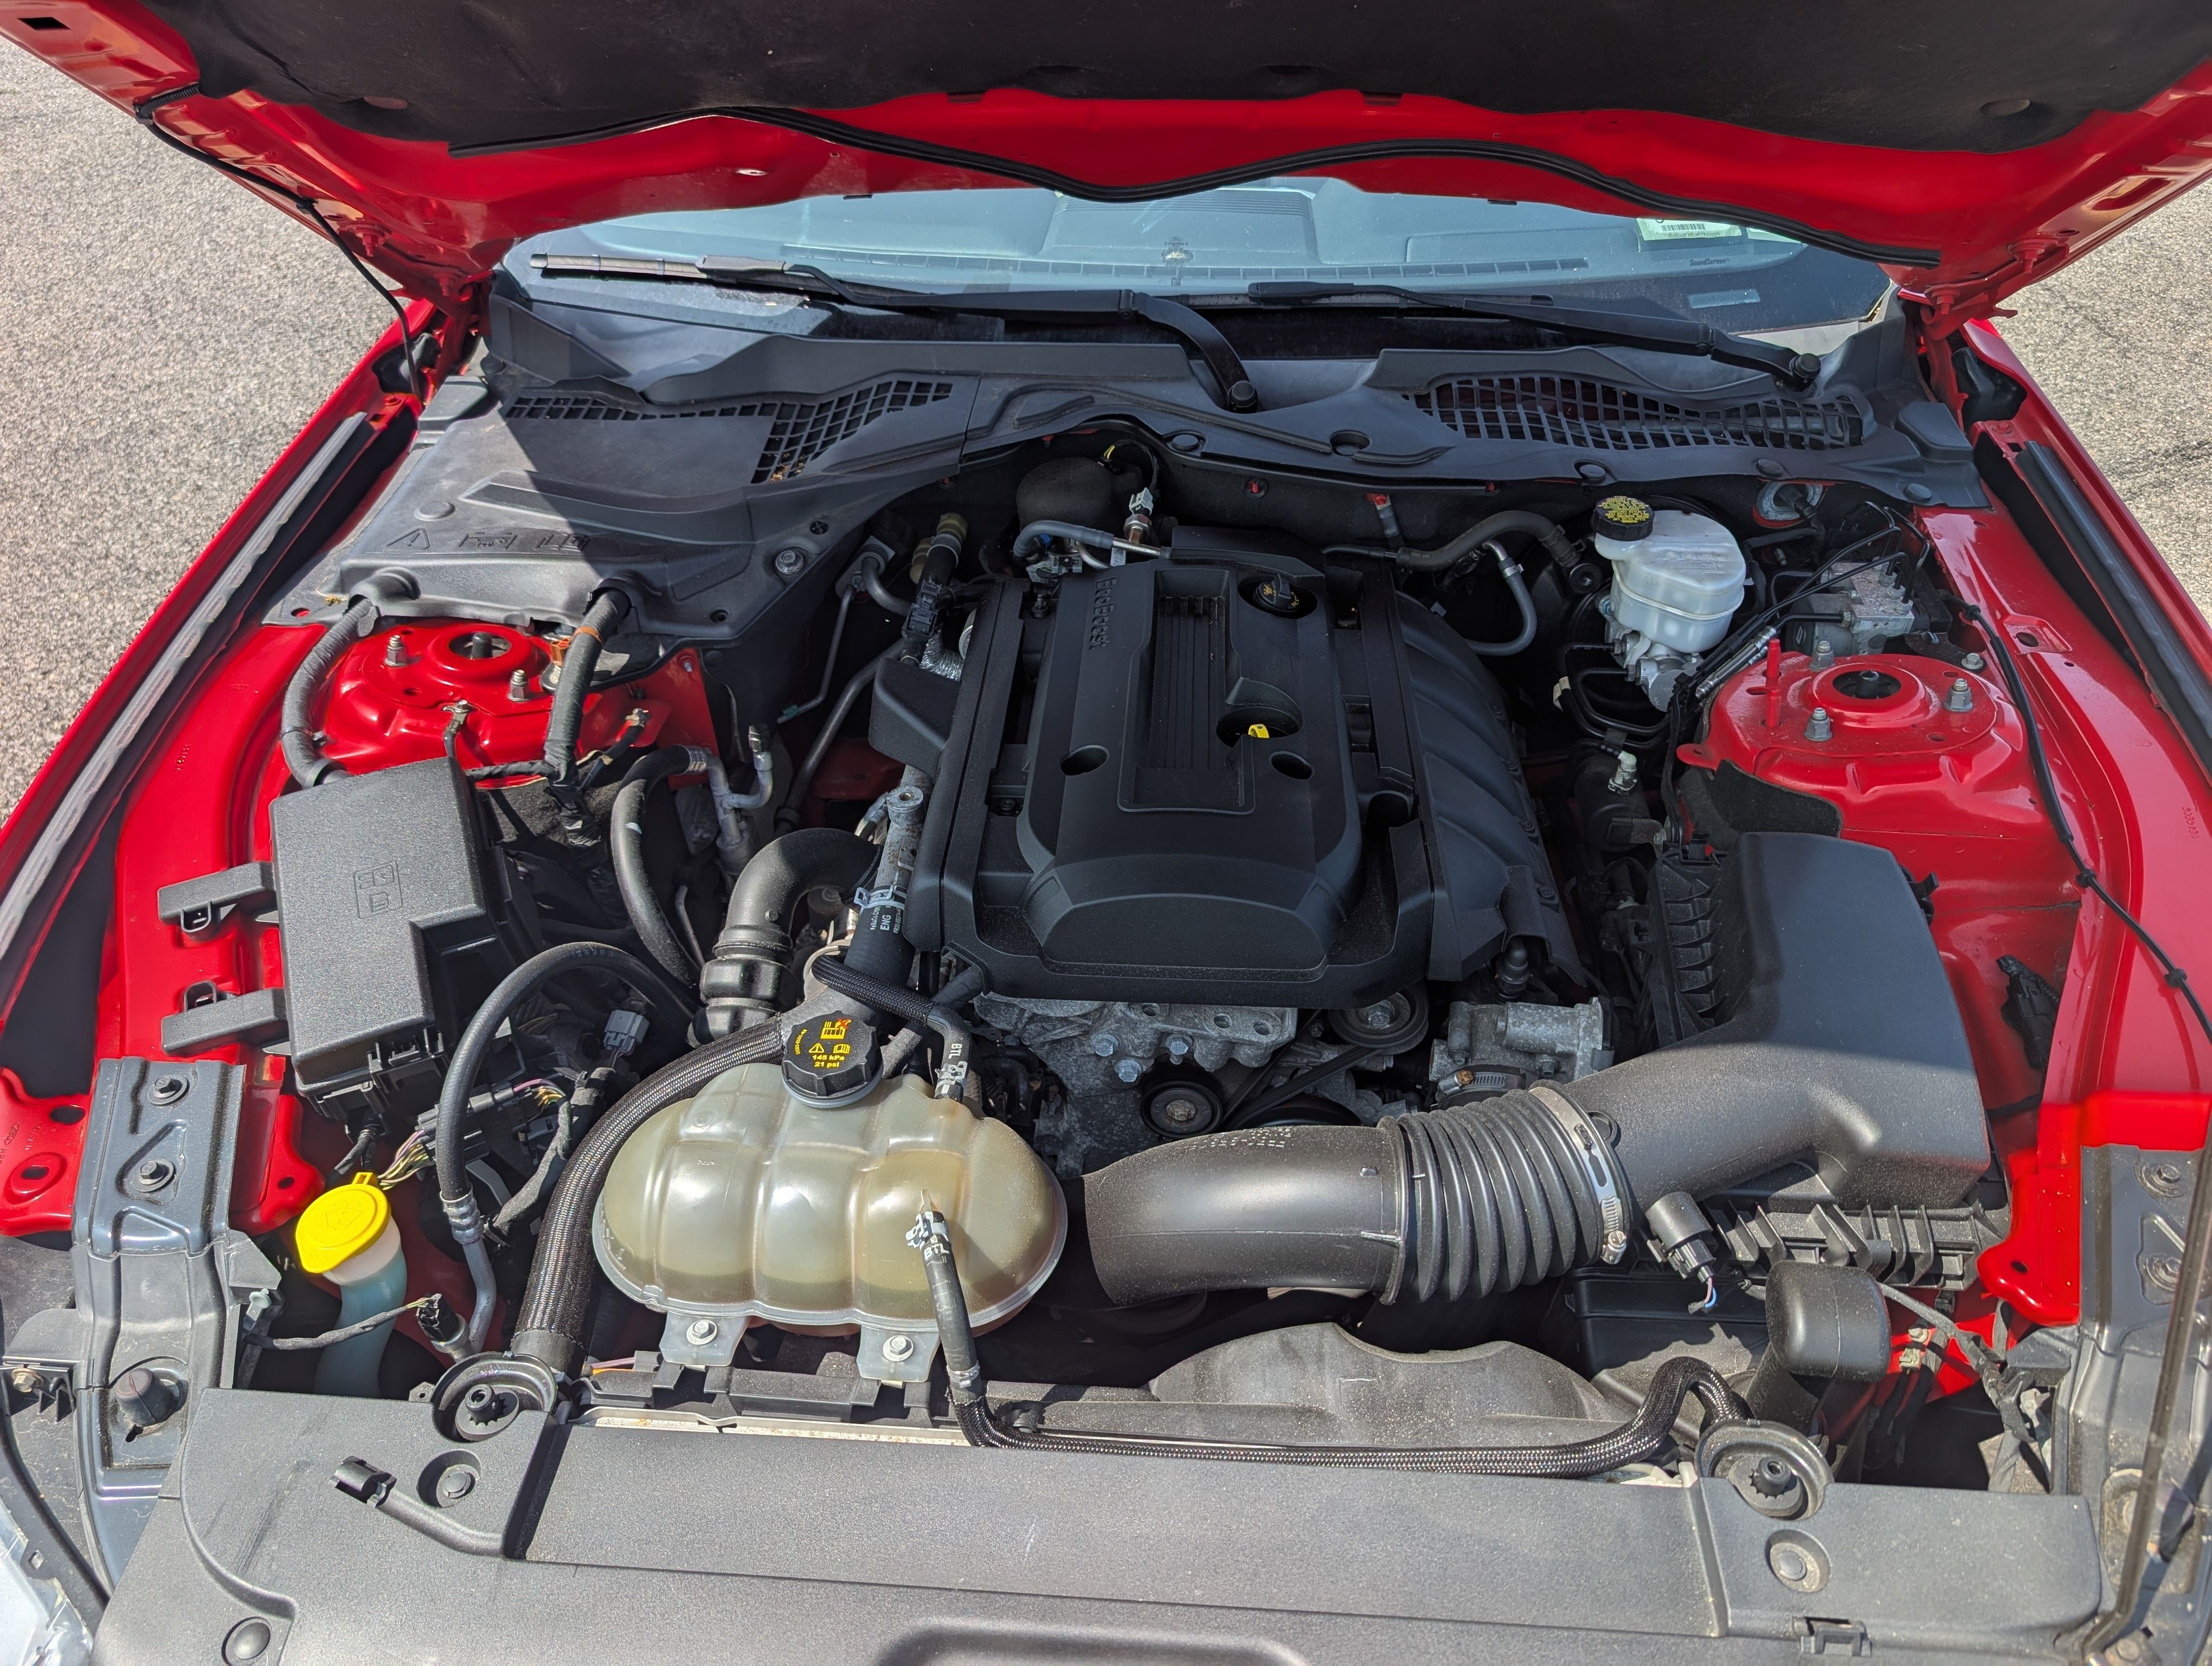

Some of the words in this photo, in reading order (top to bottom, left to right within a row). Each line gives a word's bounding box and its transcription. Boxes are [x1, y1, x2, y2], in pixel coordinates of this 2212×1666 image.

[1089, 576, 1117, 651] EcoBoost
[880, 914, 892, 931] ENG
[948, 1043, 963, 1059] BTL
[924, 1243, 950, 1261] BTL
